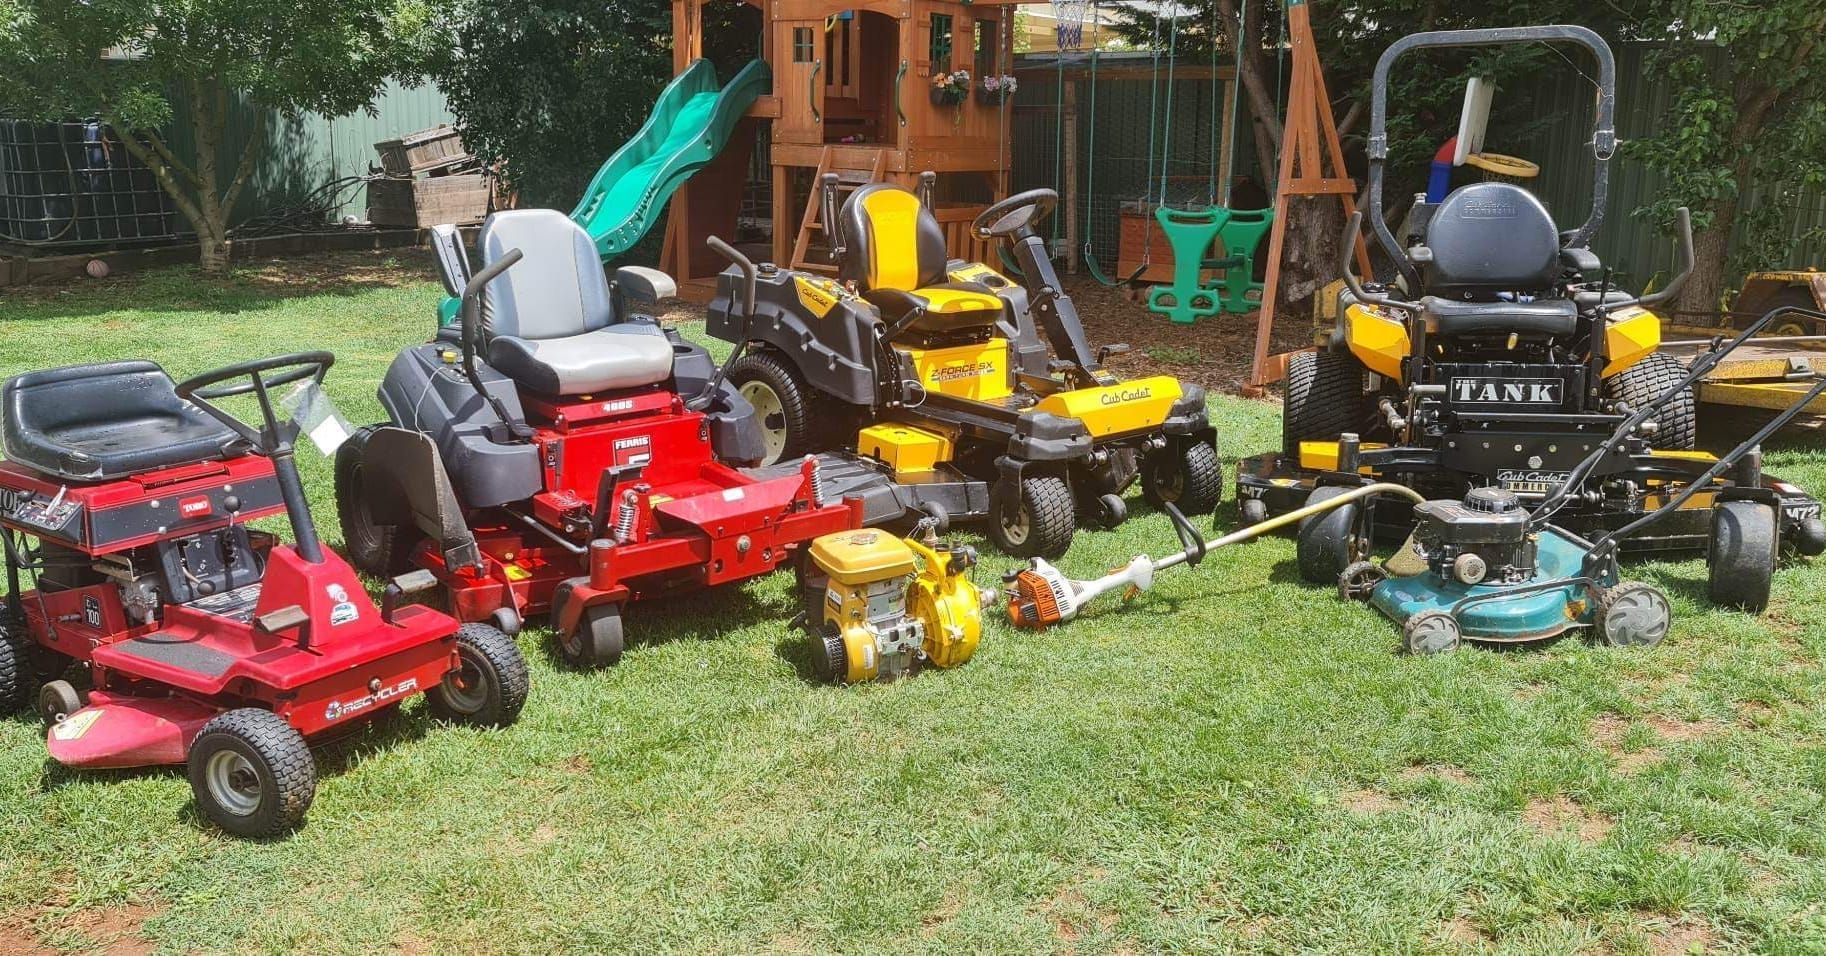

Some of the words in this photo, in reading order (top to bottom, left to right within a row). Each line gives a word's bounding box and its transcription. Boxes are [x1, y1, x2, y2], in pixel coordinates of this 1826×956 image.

[978, 361, 993, 370] SX
[1101, 392, 1121, 405] Cub
[1121, 387, 1151, 402] Cadet
[1456, 383, 1553, 402] TANK
[615, 436, 649, 450] FERRIS
[1497, 470, 1525, 481] Cub
[1525, 471, 1571, 482] Cadet
[182, 500, 208, 512] TORO
[343, 678, 417, 714] RECYCLER
